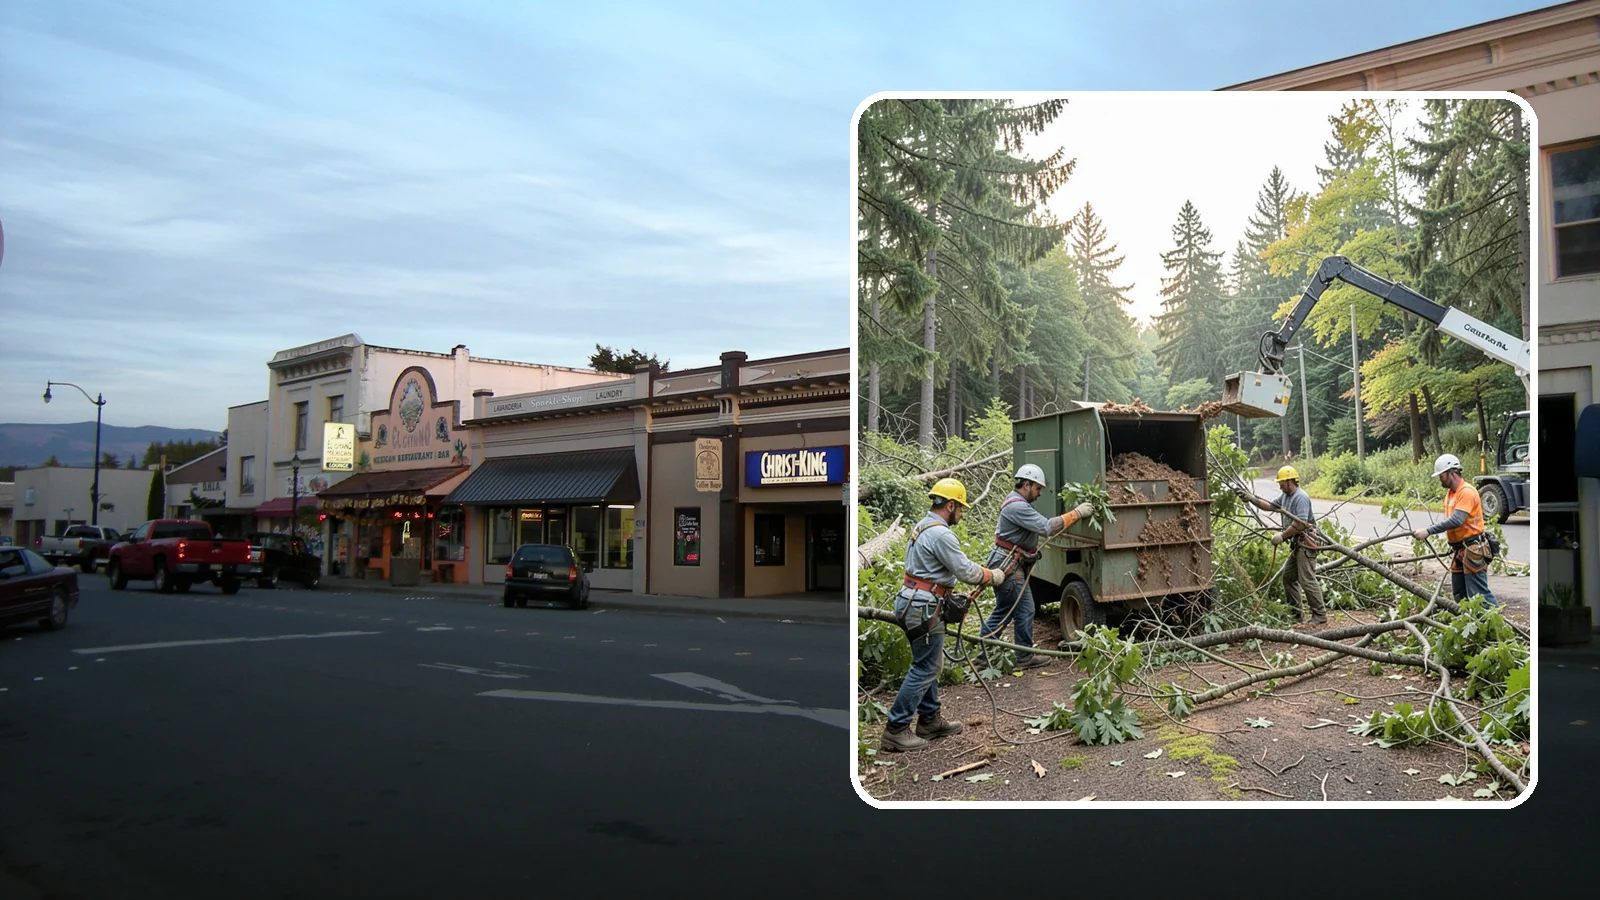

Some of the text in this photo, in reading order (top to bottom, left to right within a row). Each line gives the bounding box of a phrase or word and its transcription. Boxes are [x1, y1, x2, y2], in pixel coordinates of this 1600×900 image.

[595, 388, 624, 400] LAUNDRY
[493, 402, 523, 413] LAVANDERIA
[530, 394, 583, 410] Sparkle Shop
[373, 450, 450, 464] MEXICAN RESTAURANT BAR
[760, 449, 827, 478] CHRIST KING
